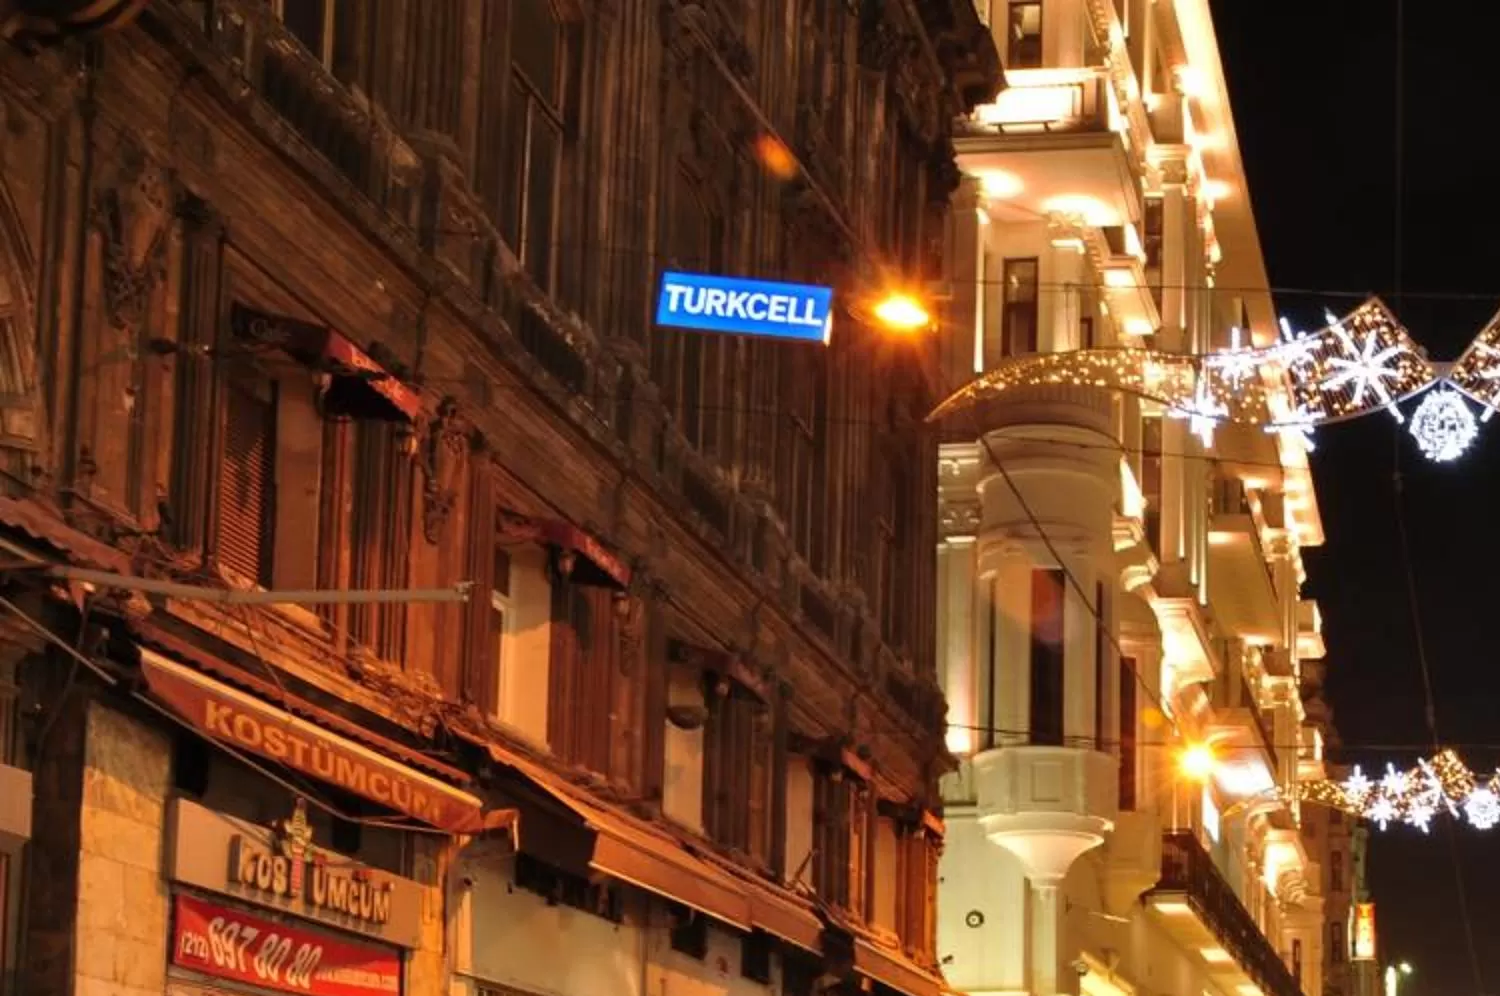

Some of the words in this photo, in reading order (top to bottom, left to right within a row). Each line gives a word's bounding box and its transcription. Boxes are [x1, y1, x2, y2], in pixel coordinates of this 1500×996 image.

[665, 283, 823, 327] TURKCELL
[207, 916, 260, 972] 697
[253, 933, 294, 983] 80
[285, 942, 325, 989] 80
